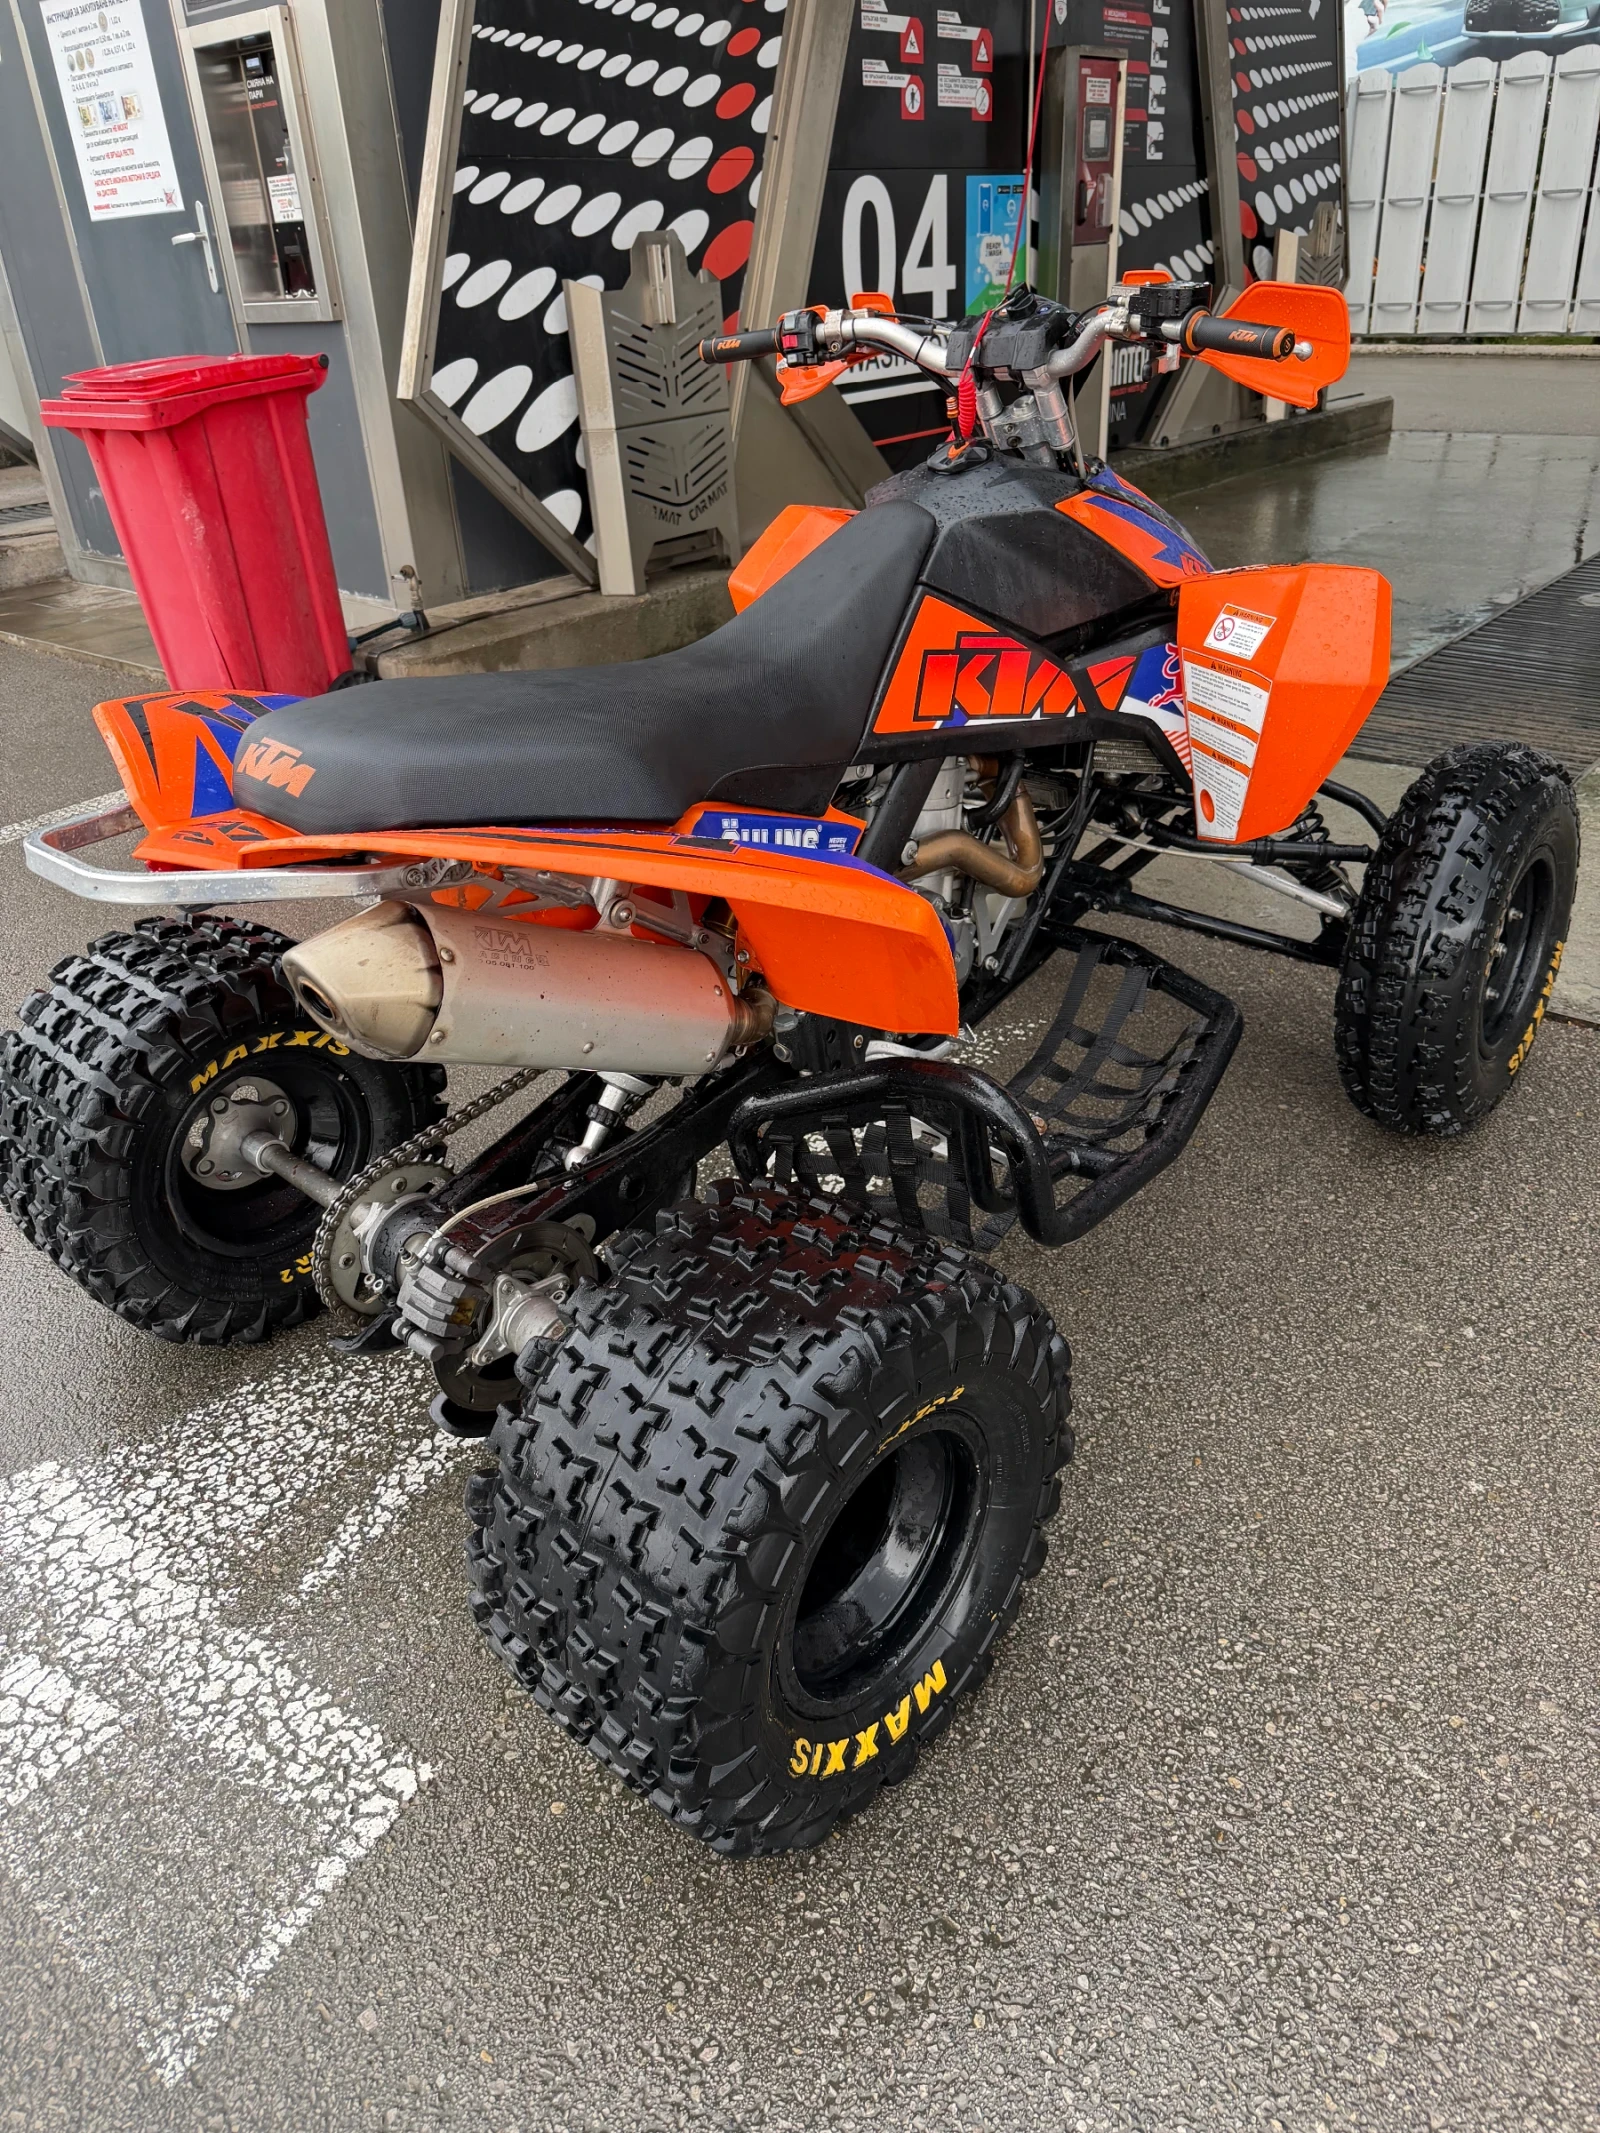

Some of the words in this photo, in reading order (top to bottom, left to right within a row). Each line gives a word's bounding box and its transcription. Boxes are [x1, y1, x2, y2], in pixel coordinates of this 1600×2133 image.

[249, 89, 263, 100] ПАРИ
[842, 174, 956, 319] 04
[986, 242, 1001, 250] READY
[717, 339, 741, 350] KTM
[1228, 329, 1258, 342] KTM
[918, 636, 1136, 717] KTM
[1217, 662, 1242, 678] WARNING
[1217, 716, 1237, 731] WARNING
[236, 737, 316, 798] KTM
[472, 926, 532, 956] KTM
[188, 1030, 351, 1095] MAXXIS
[788, 1658, 949, 1781] MAXXIS
